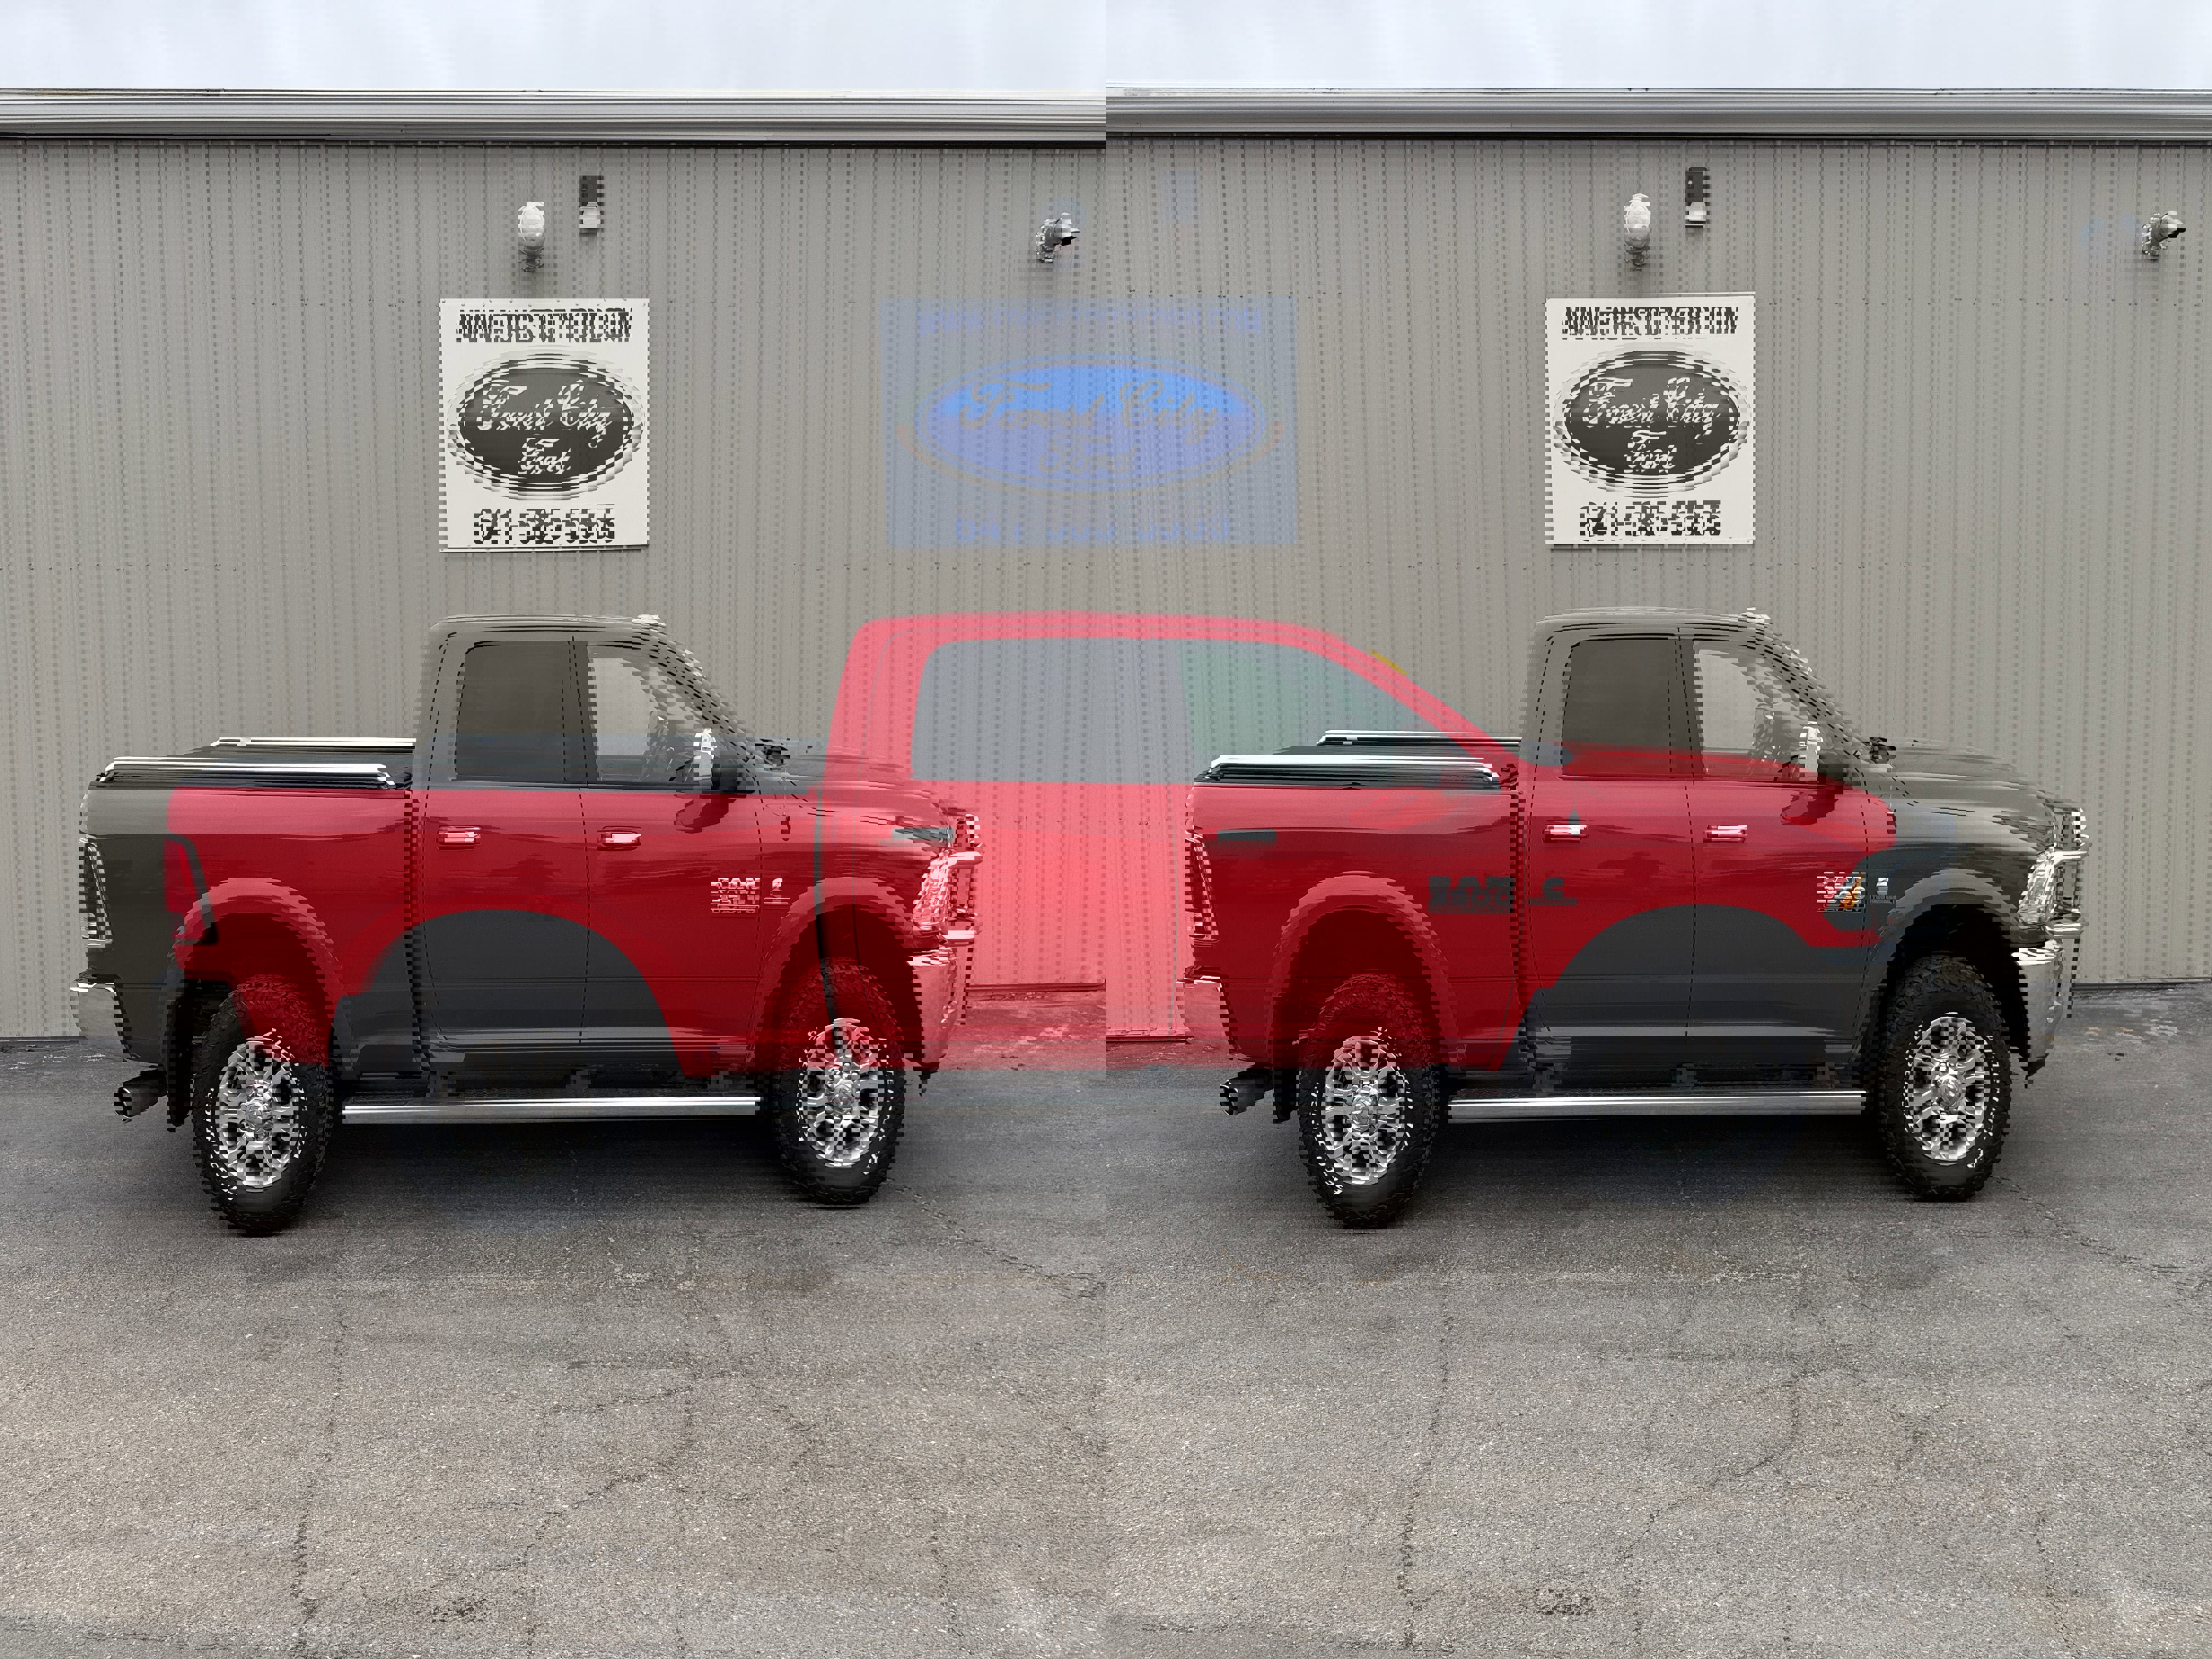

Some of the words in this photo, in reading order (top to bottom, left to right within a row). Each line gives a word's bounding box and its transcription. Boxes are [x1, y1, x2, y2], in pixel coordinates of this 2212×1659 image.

[916, 307, 1262, 340] WWW.FORESTCITYFORD.COM
[958, 379, 1106, 430] Forest
[1118, 379, 1221, 445] City
[1037, 433, 1139, 475] Ford
[953, 503, 1230, 541] 641-585-5555
[1428, 876, 1515, 890] RAM
[1428, 890, 1515, 904] 3500
